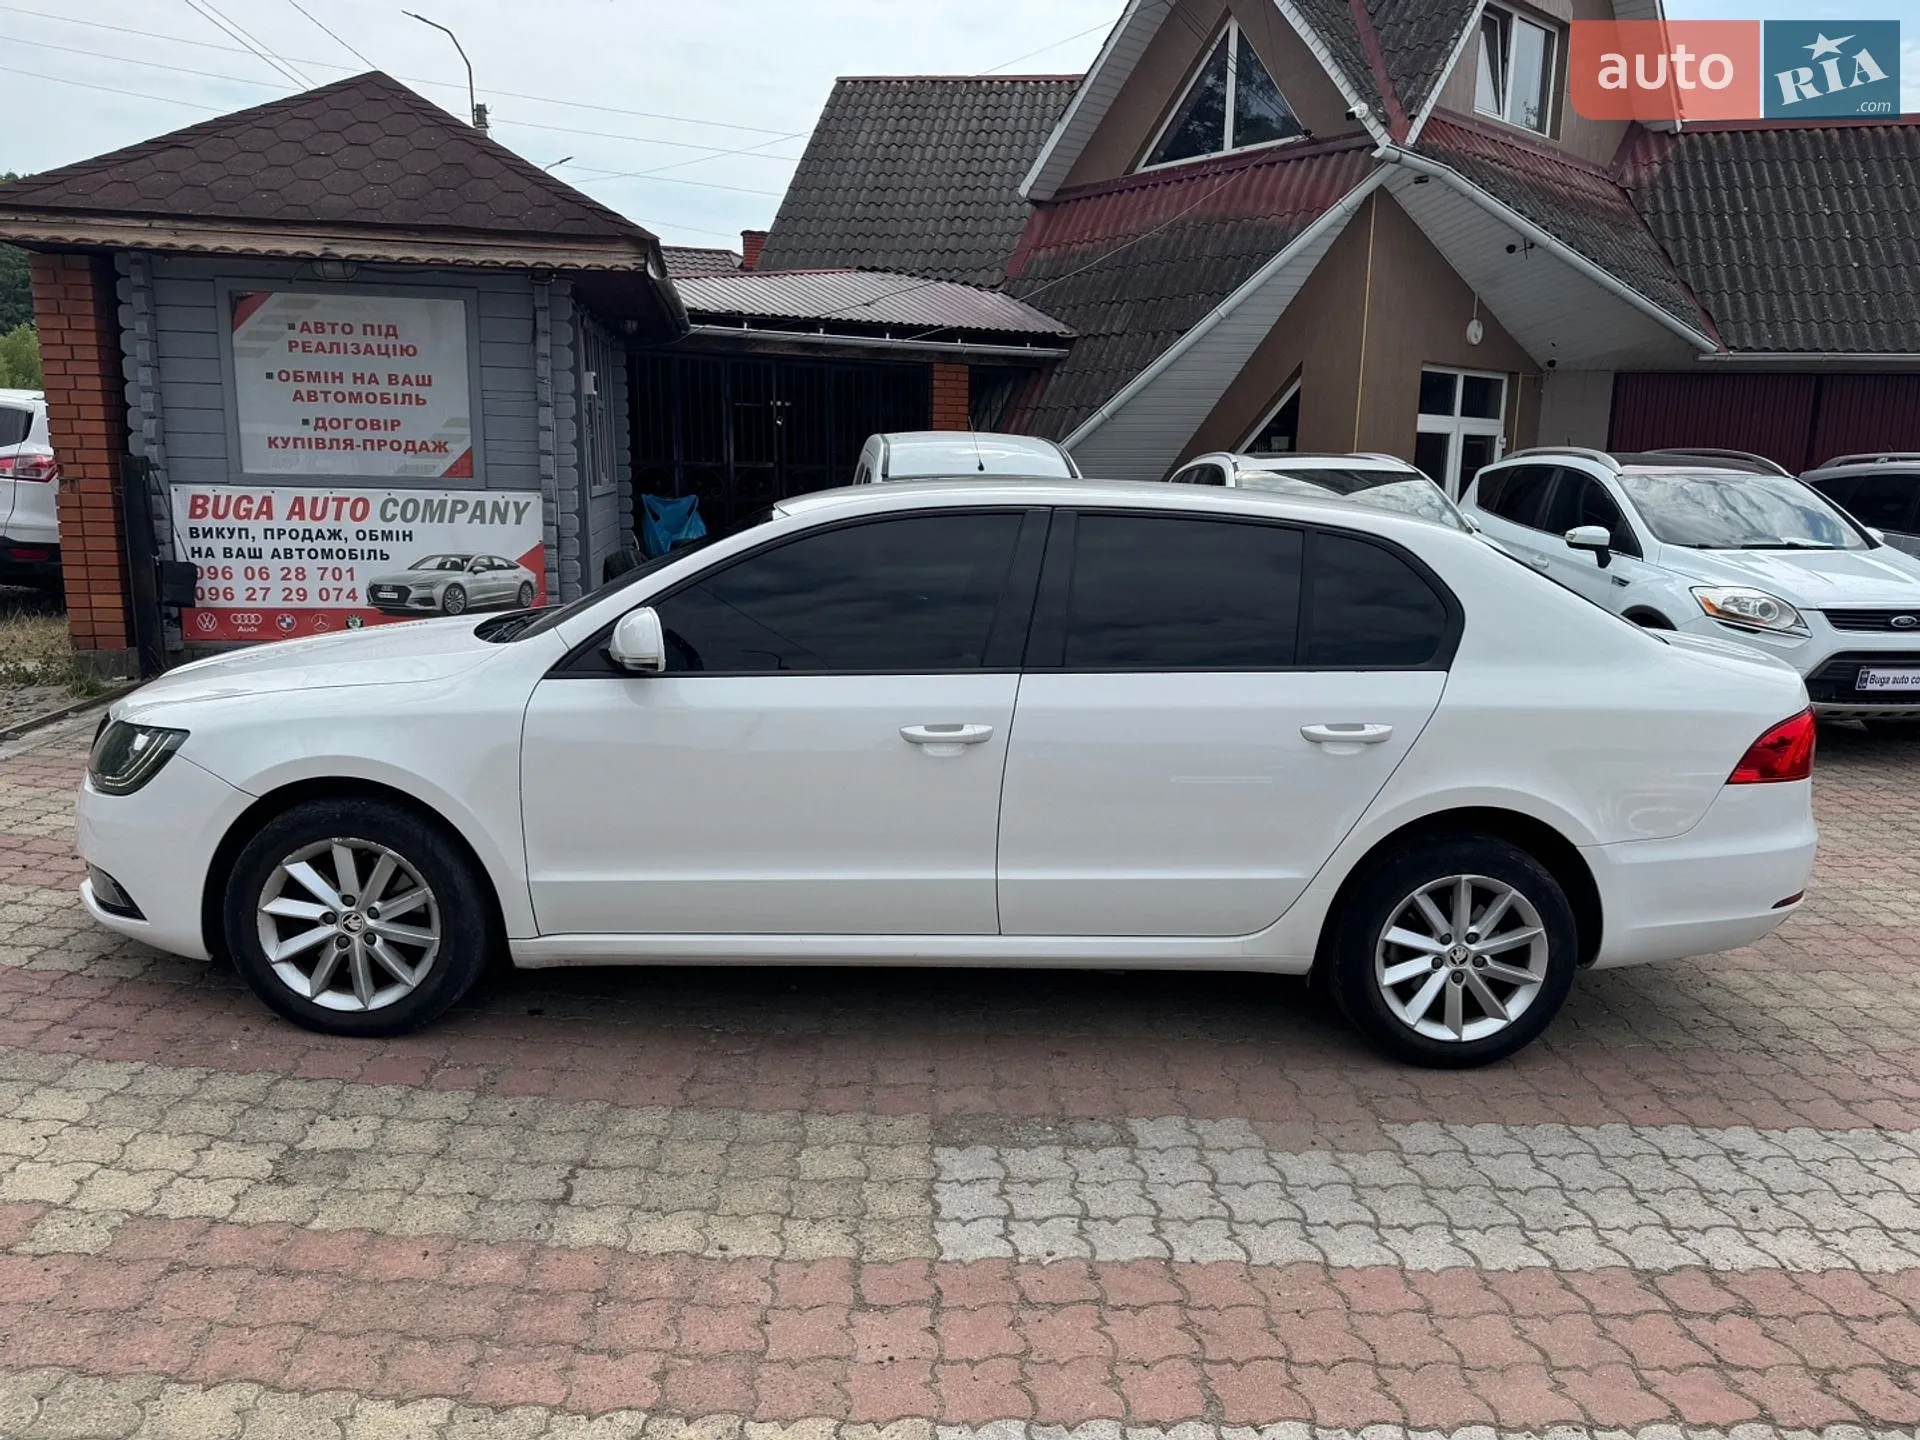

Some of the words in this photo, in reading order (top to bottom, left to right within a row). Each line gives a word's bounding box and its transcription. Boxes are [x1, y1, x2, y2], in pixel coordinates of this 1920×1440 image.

[299, 320, 354, 336] АВТО
[362, 322, 399, 340] ПІД
[287, 340, 418, 359] РЕАЛІЗАЦІЮ
[277, 369, 344, 384] ОБМІН
[352, 371, 380, 386] НА
[387, 373, 433, 388] ВАШ
[292, 389, 427, 406] АВТОМОБІЛЬ
[313, 416, 401, 432] ДОГОВІР
[266, 435, 449, 455] КУПІВЛЯ-ПРОДАЖ
[188, 493, 275, 521] BUGA
[285, 495, 371, 523] AUTO
[379, 497, 532, 526] COMPANY
[189, 526, 256, 543] ВИКУП,
[262, 527, 348, 544] ПРОДАЖ,
[354, 528, 414, 543] ОБМІН
[190, 546, 217, 560] НА
[222, 546, 263, 561] ВАШ
[270, 547, 391, 562] АВТОМОБІЛЬ
[244, 565, 270, 582] 06
[280, 566, 307, 582] 28
[317, 566, 357, 582] 701
[195, 586, 235, 602] 096
[244, 586, 271, 602] 27
[281, 586, 308, 602] 29
[318, 586, 359, 603] 074
